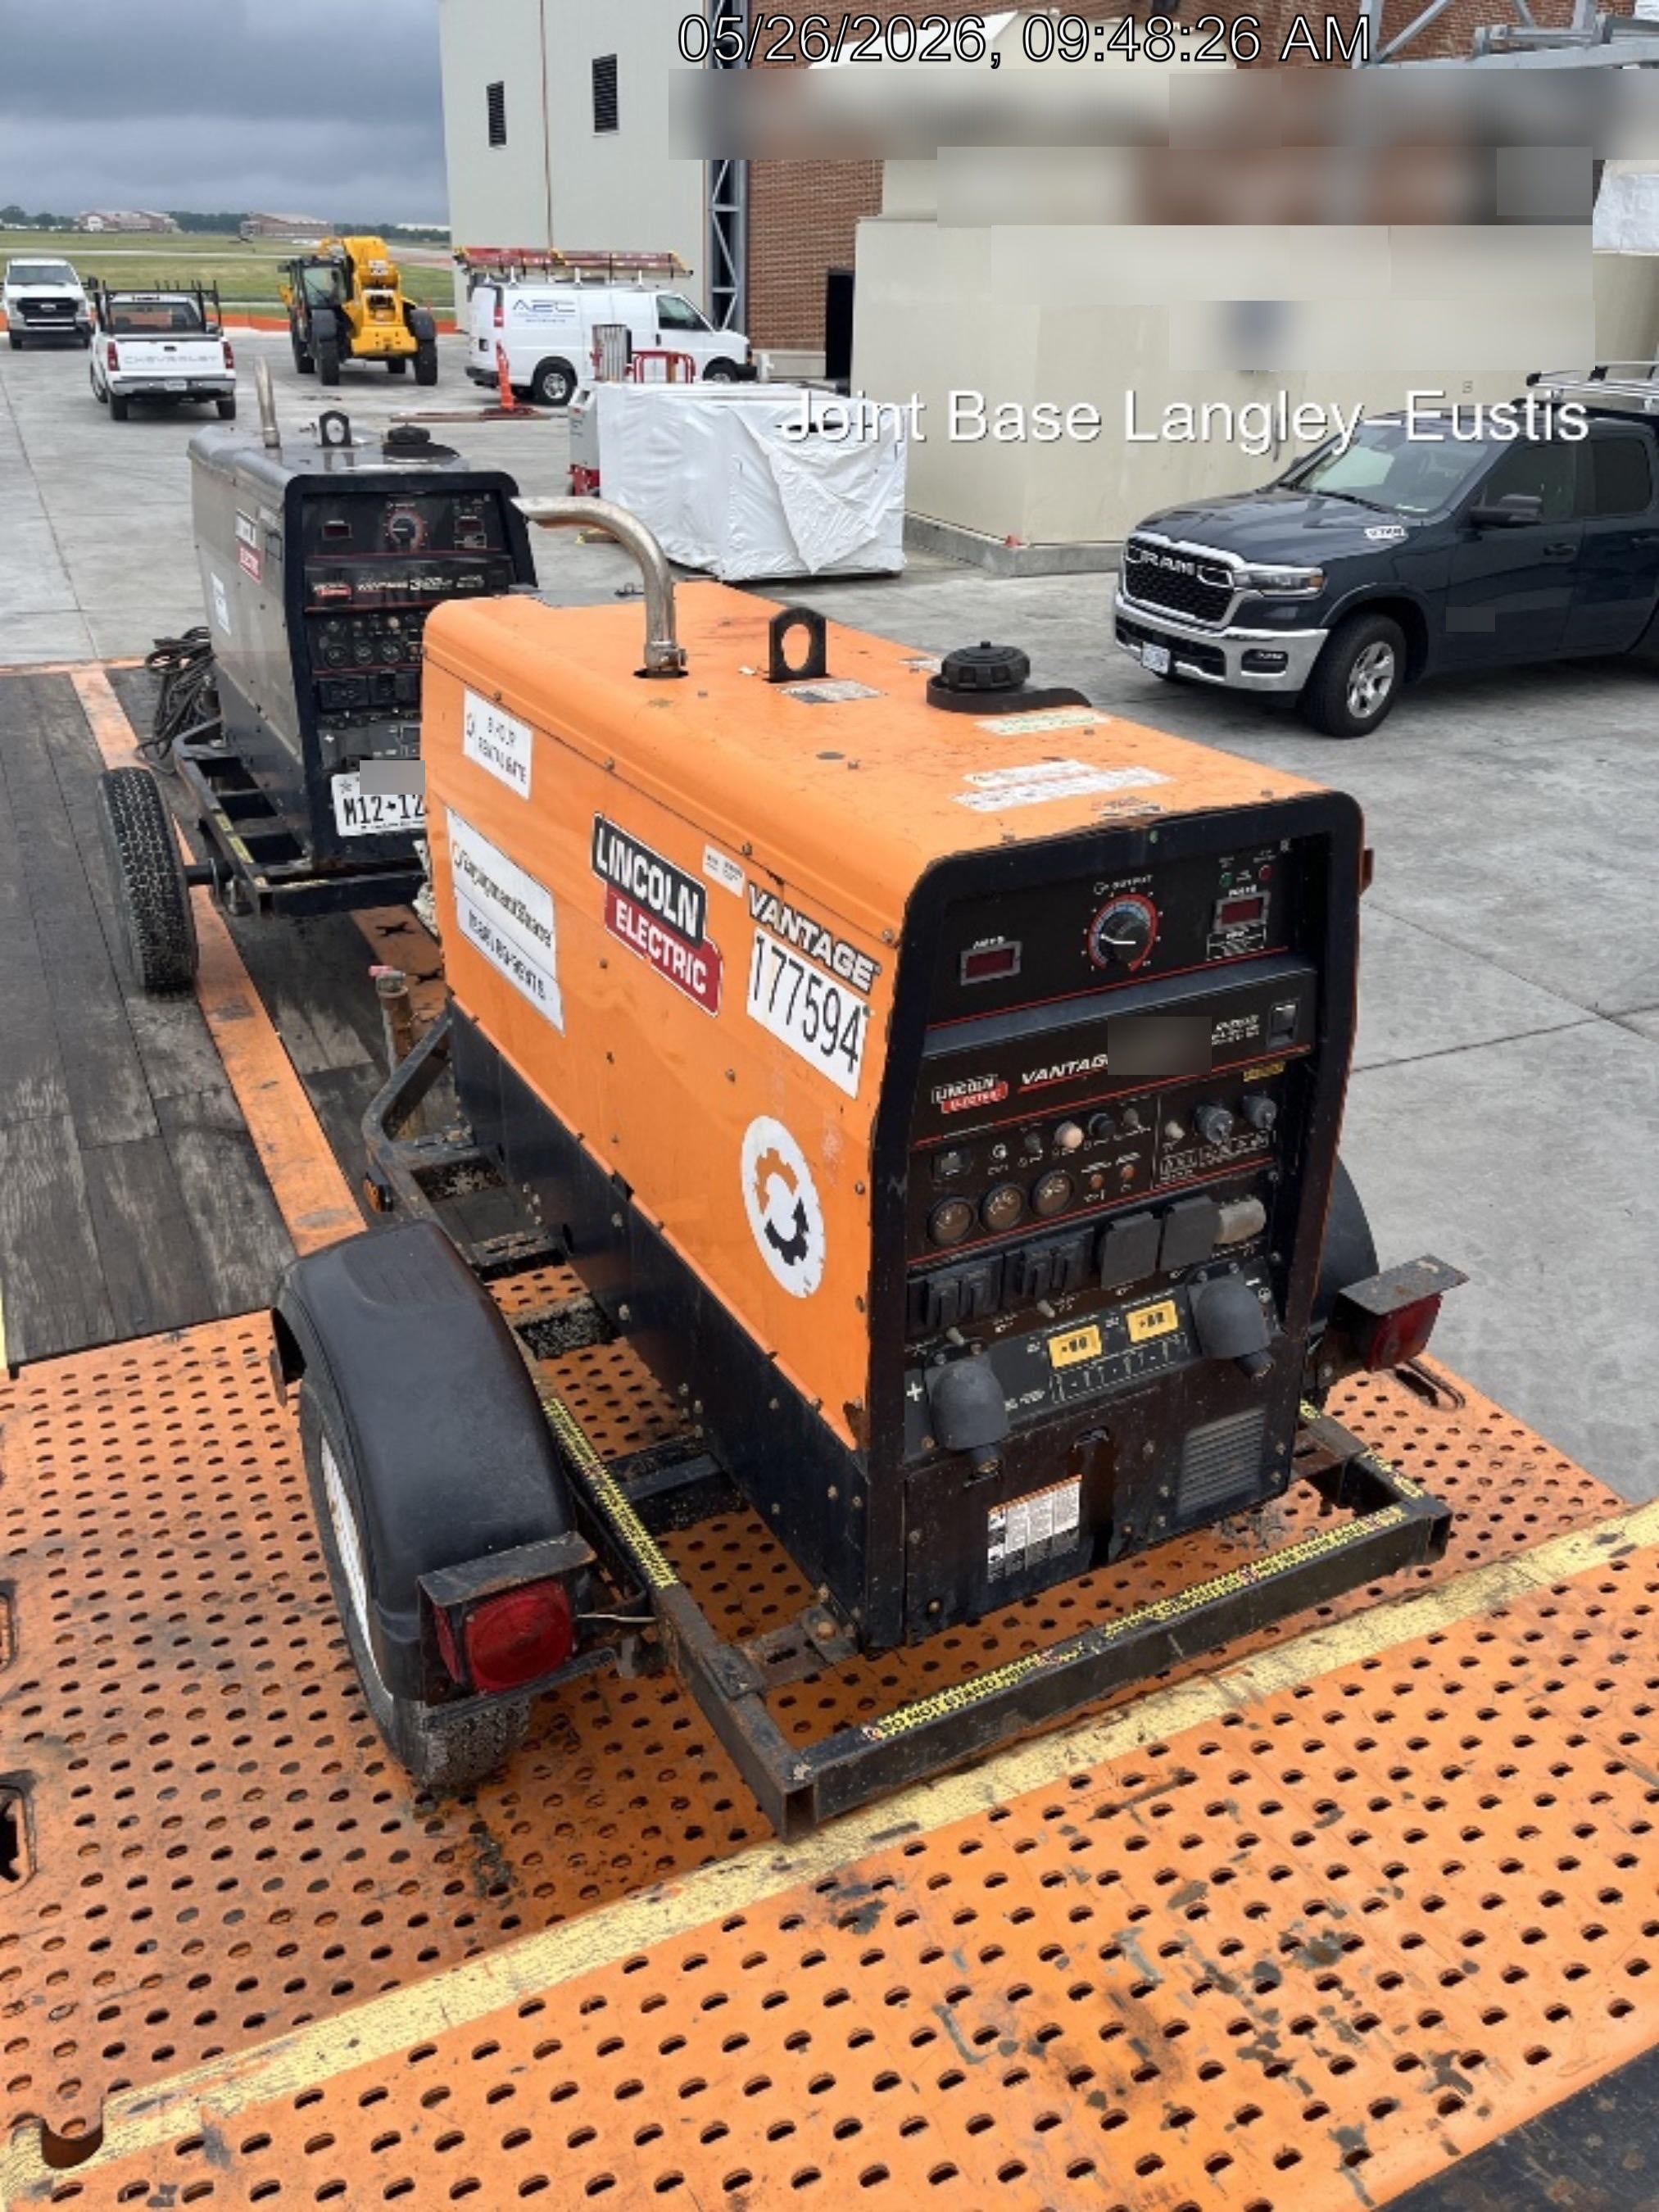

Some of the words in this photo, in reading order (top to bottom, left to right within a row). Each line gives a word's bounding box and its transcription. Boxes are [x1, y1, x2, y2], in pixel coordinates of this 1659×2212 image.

[513, 299, 576, 313] AEC
[125, 356, 218, 365] CHEVROLET
[1142, 550, 1195, 575] RAM
[596, 826, 700, 939] LINCOLN
[615, 897, 708, 996] ELECTRIC
[748, 882, 880, 995] VANTAGE
[753, 936, 860, 1074] 177594
[1022, 1054, 1108, 1085] VANTAG
[935, 1075, 995, 1102] LINCOLN
